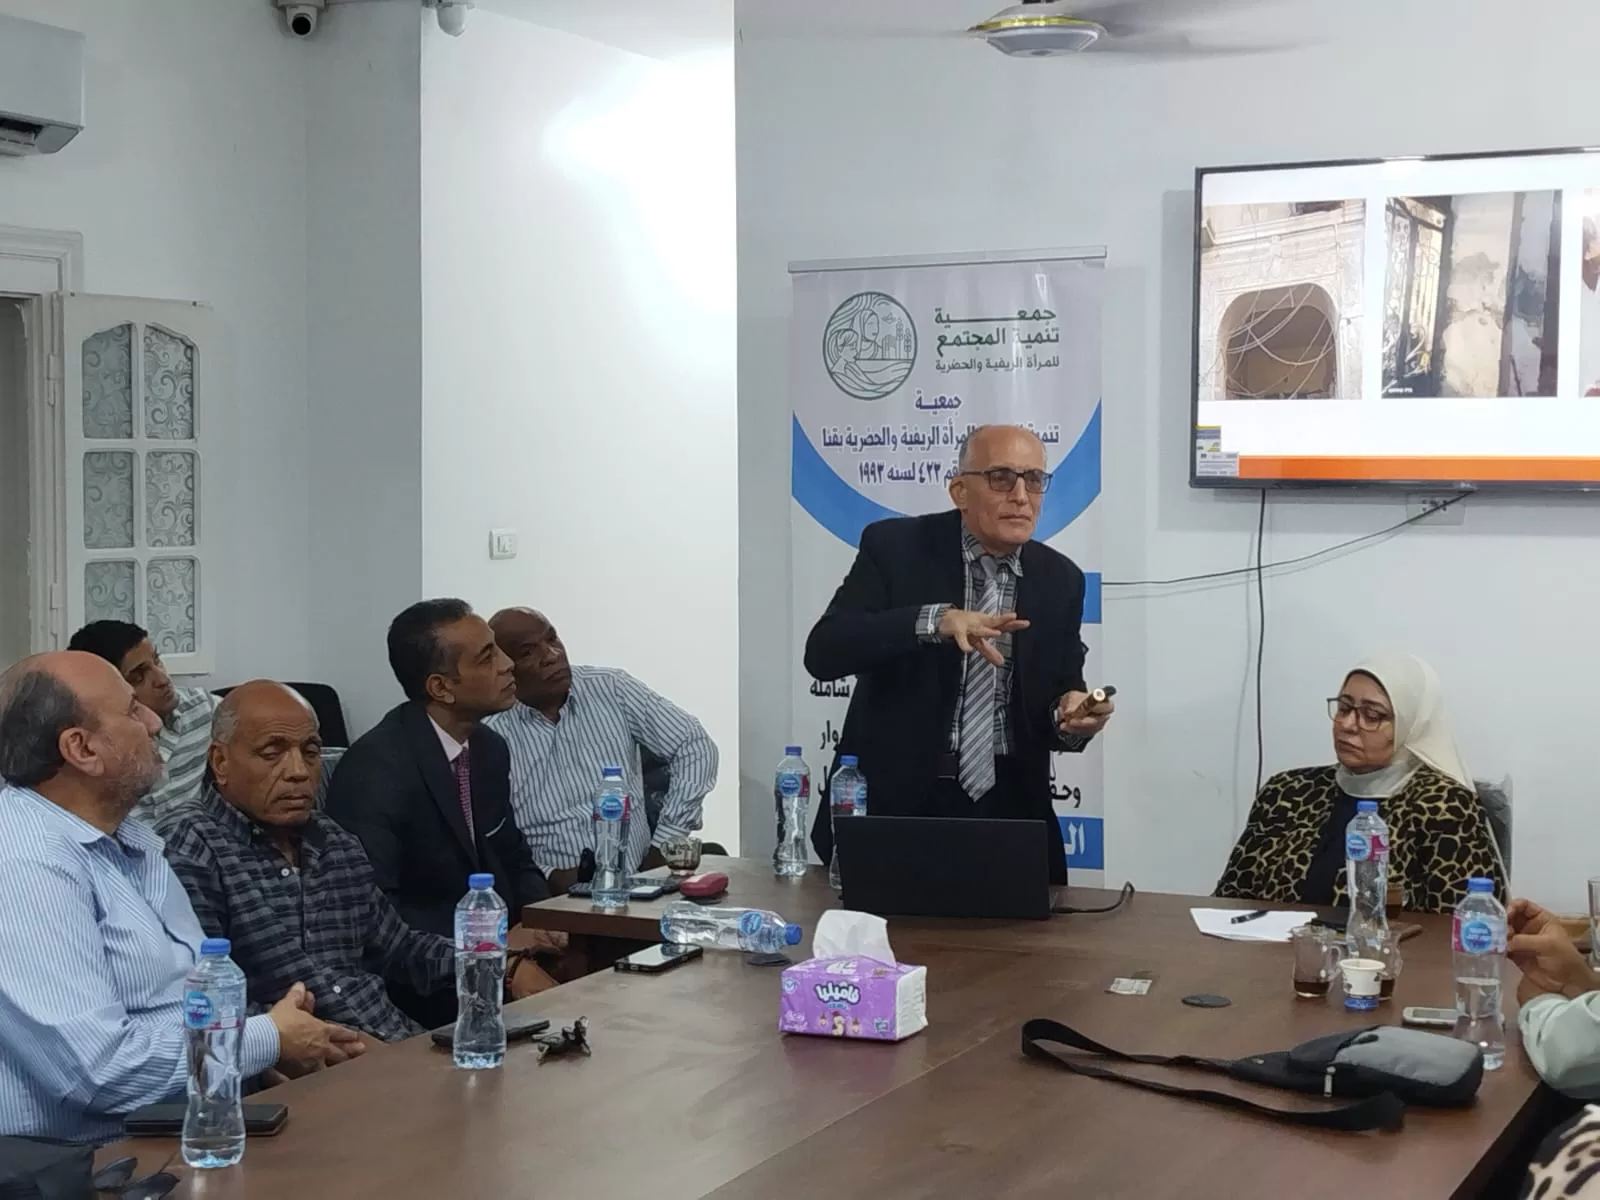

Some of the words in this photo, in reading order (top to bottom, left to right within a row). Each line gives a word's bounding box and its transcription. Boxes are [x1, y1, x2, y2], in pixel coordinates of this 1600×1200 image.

[936, 327, 1006, 358] المجتمع
[1012, 327, 1059, 349] تنمية
[935, 358, 983, 373] والحضرية
[985, 357, 1023, 371] الريفية
[1026, 354, 1059, 371] للمرأة
[915, 390, 962, 415] جمعية
[845, 426, 898, 452] والحضرية
[900, 425, 940, 451] الريفية
[943, 460, 959, 488] قم
